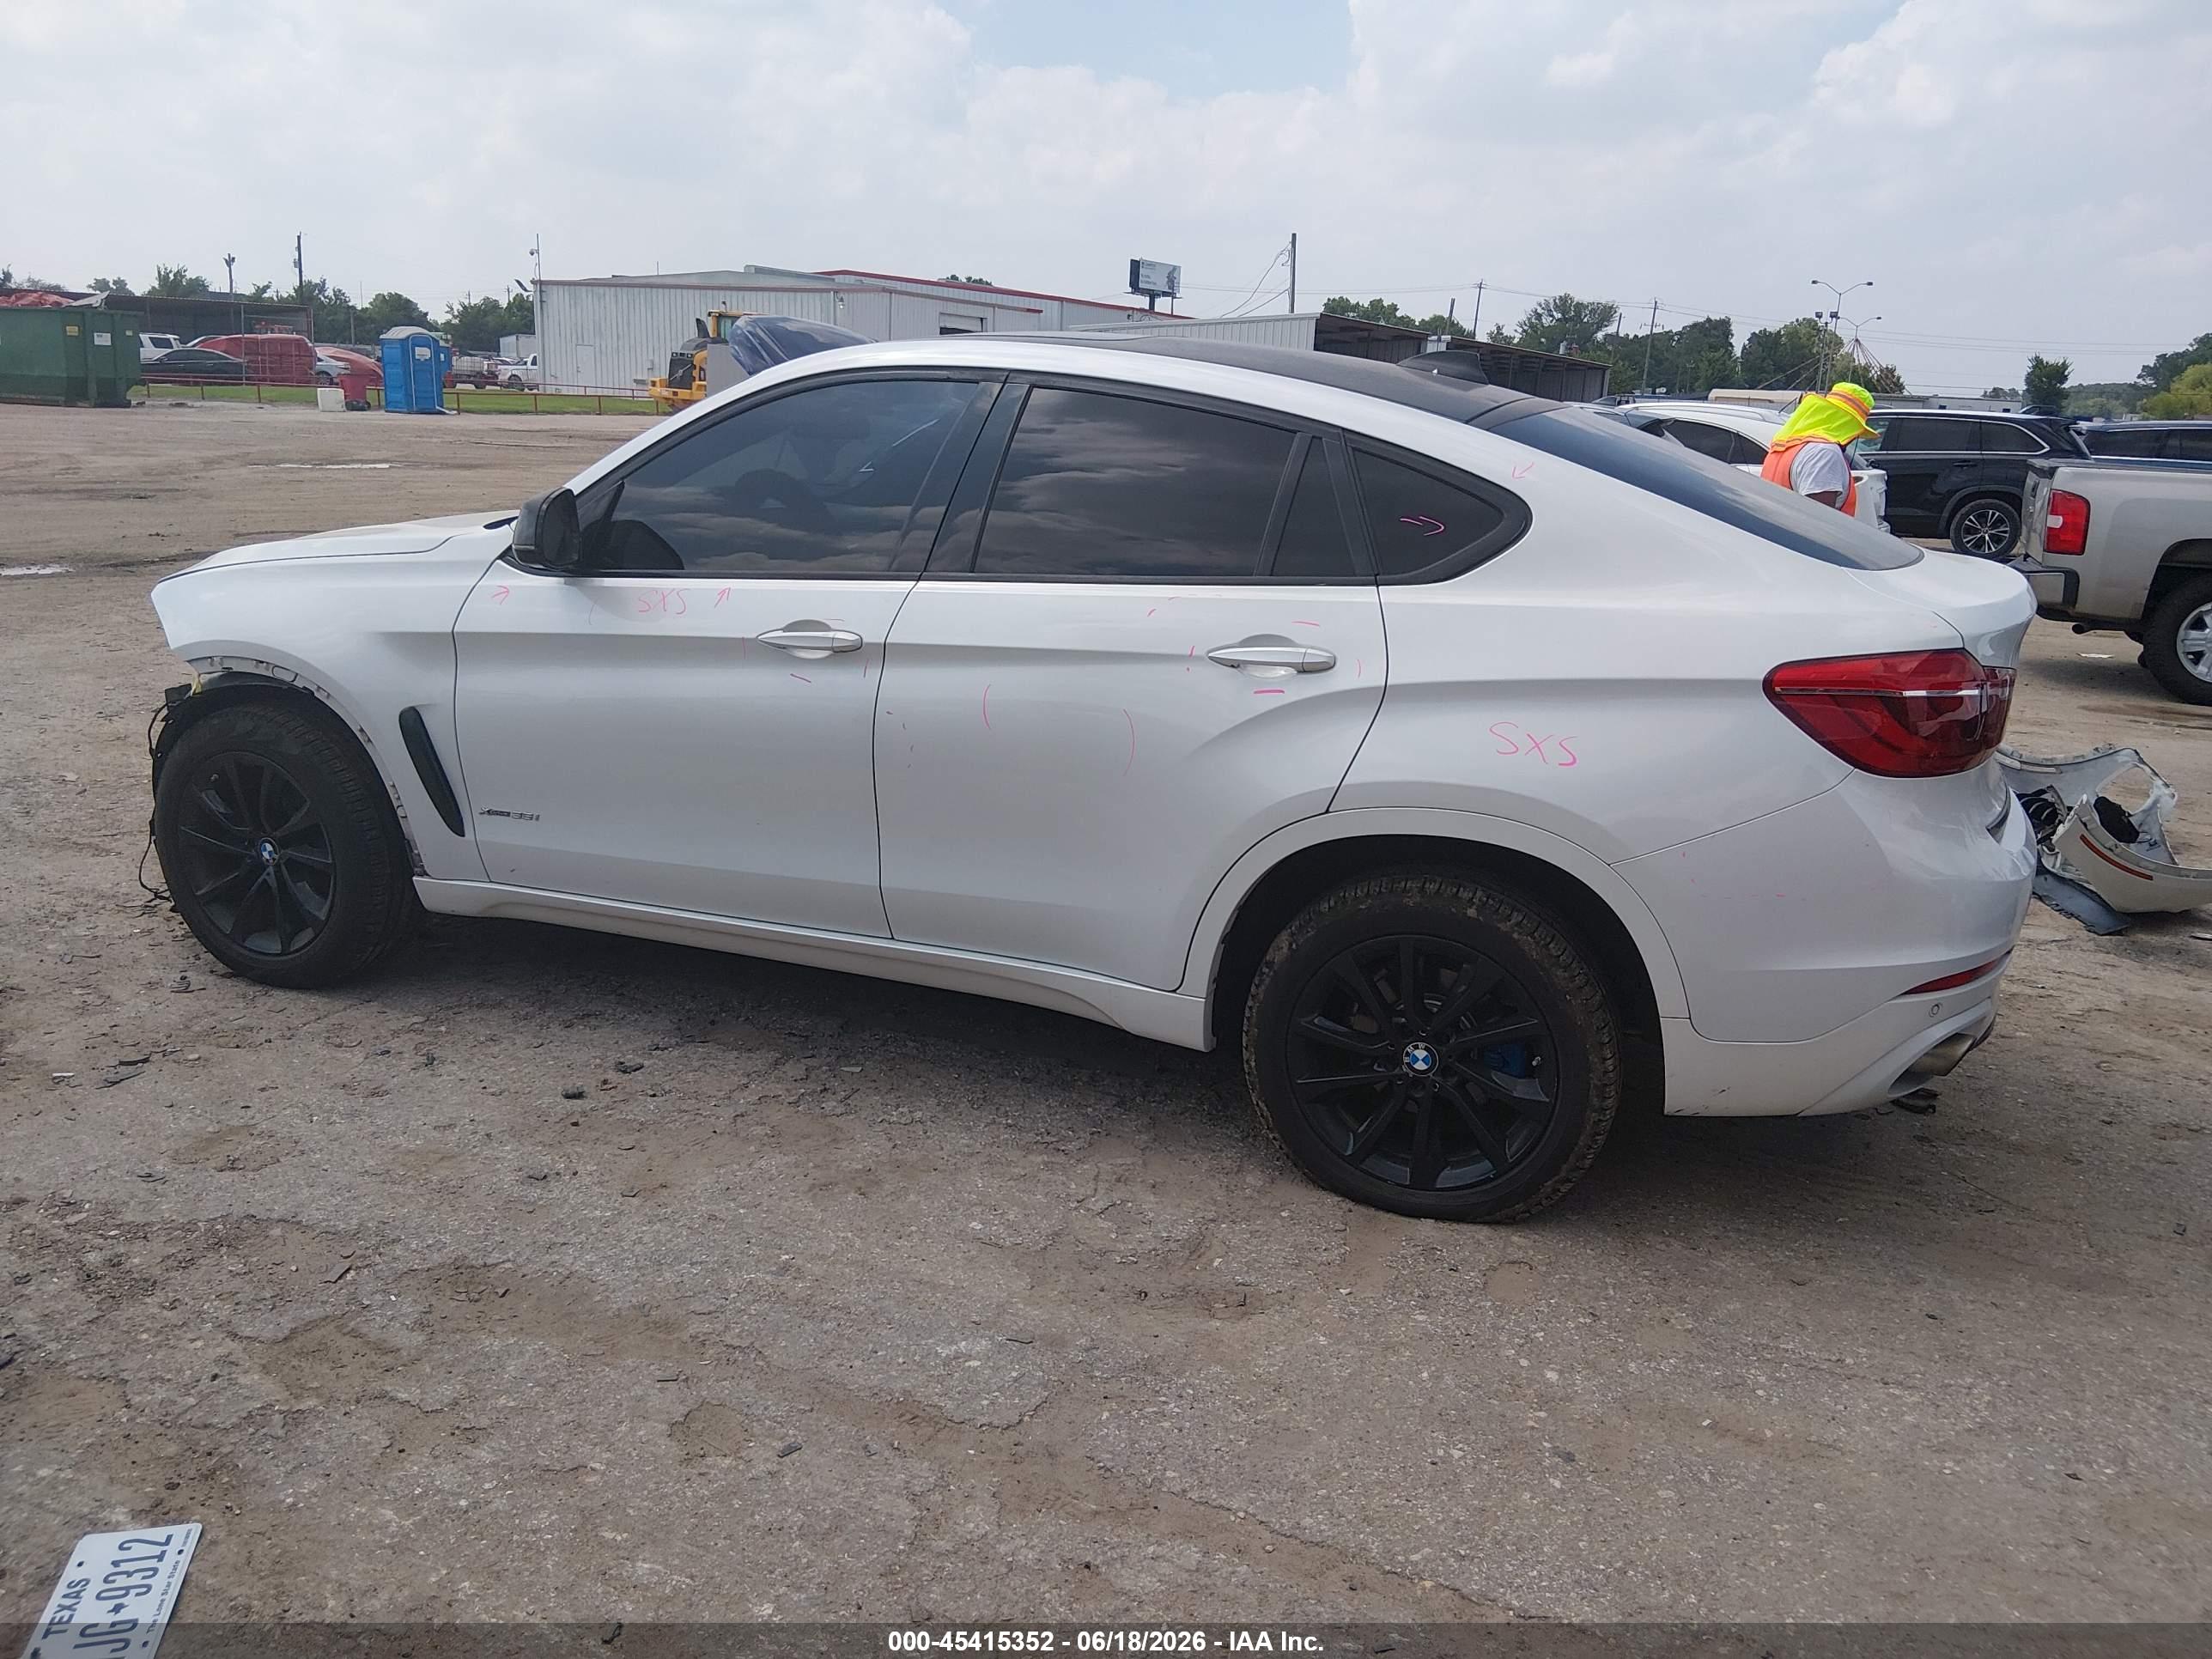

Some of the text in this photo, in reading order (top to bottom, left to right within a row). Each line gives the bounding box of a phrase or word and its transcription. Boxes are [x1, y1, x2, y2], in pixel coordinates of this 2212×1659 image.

[1489, 721, 1578, 767] SXS
[41, 1577, 91, 1640] TEXAS
[146, 1559, 180, 1634] The Lone Star State
